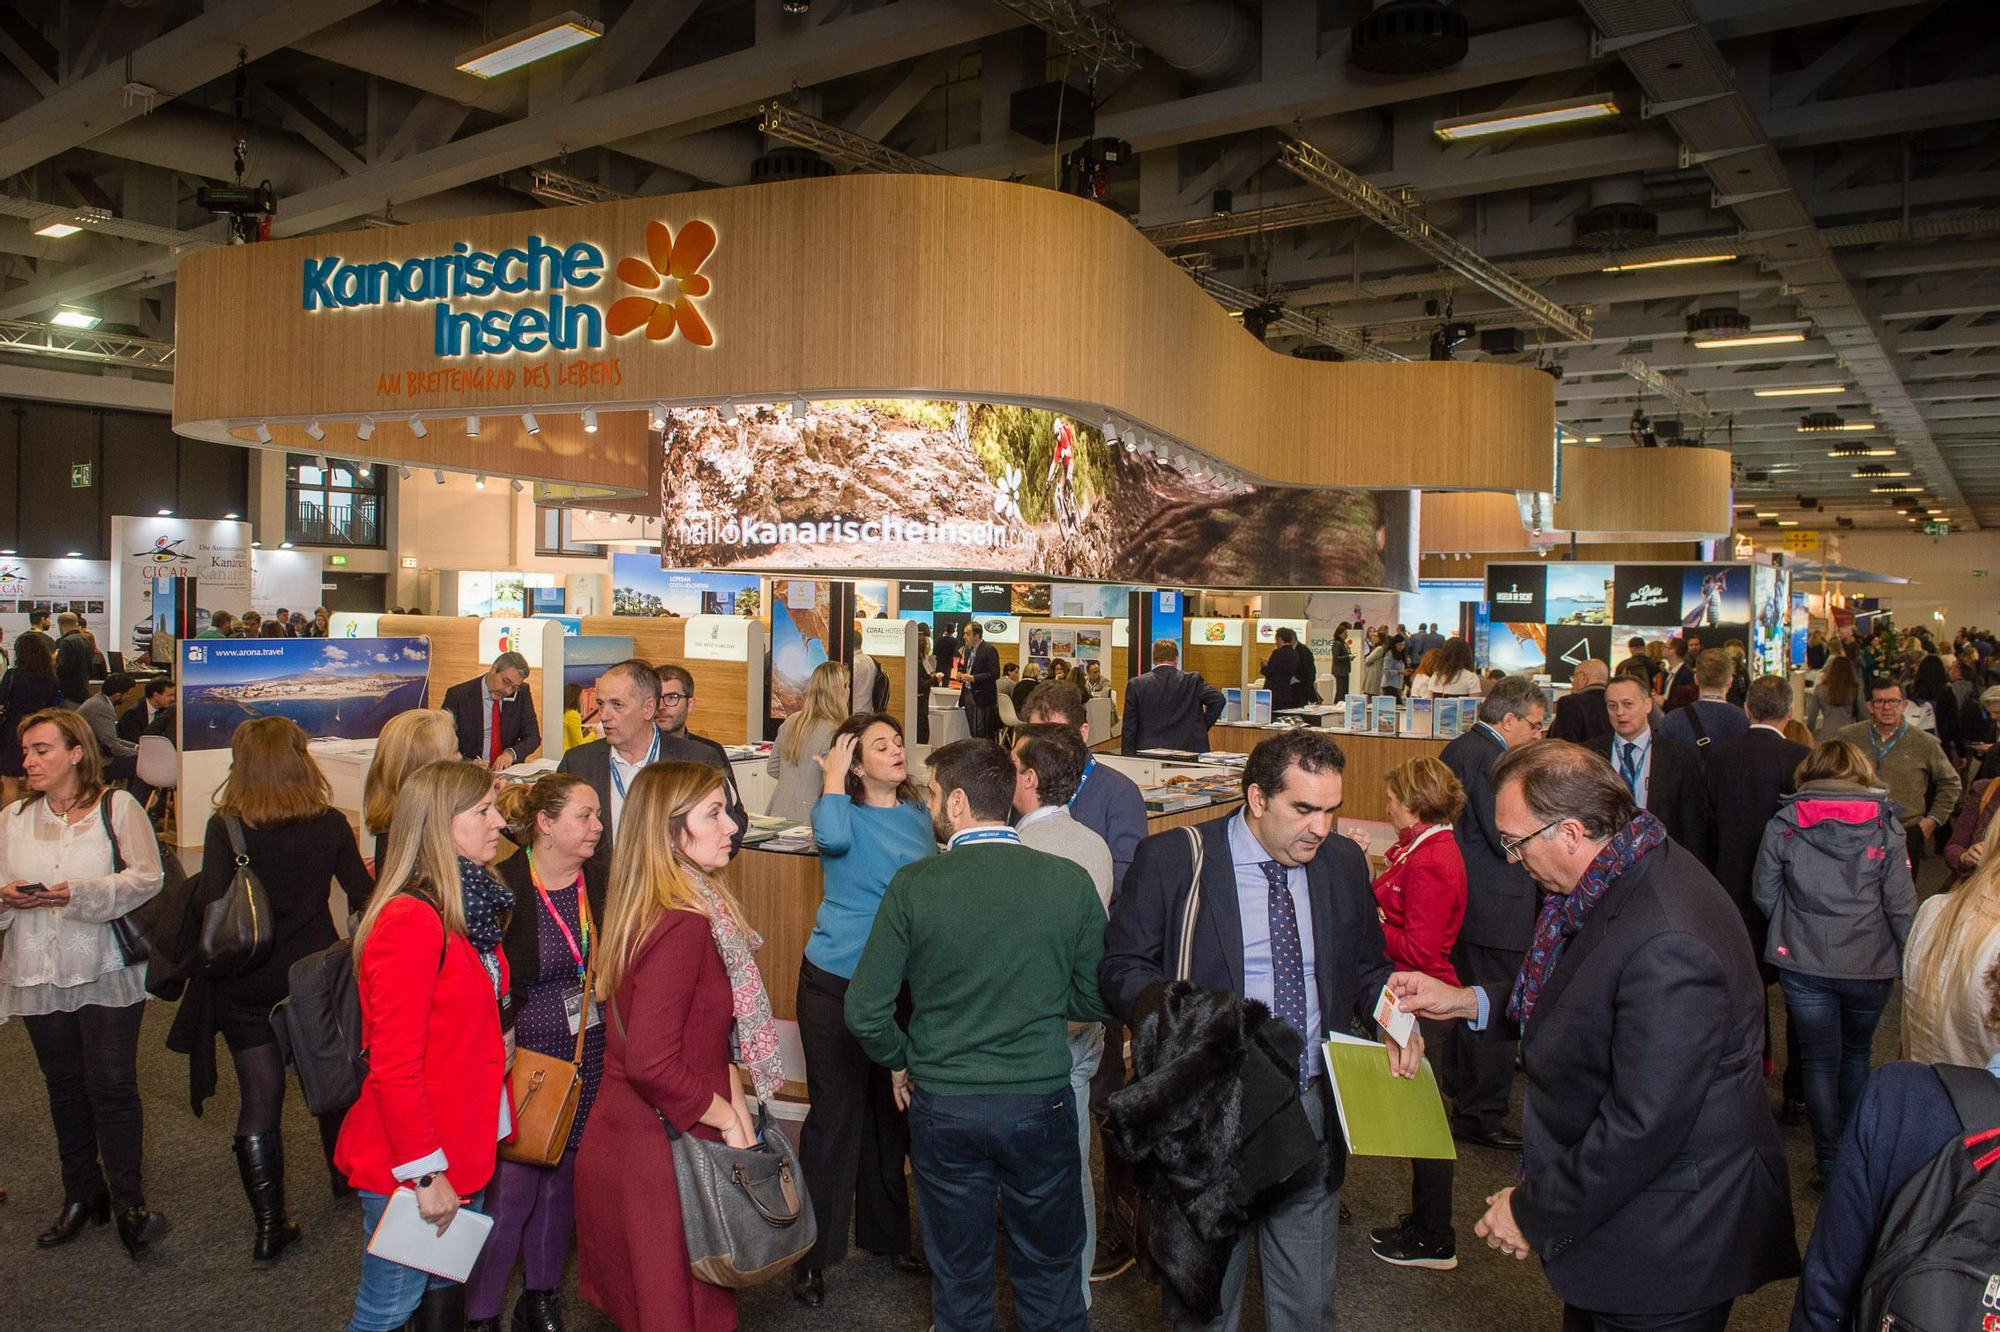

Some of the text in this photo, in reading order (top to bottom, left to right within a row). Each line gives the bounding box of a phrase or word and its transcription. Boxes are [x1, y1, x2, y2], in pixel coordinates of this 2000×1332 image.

[303, 235, 604, 310] Kanarische
[435, 294, 602, 356] Inseln
[376, 357, 622, 398] AM BREITENGRAD DES LEBENS
[142, 565, 188, 579] CICAR
[885, 627, 906, 635] HOTELS
[215, 646, 284, 657] www.arona.travel
